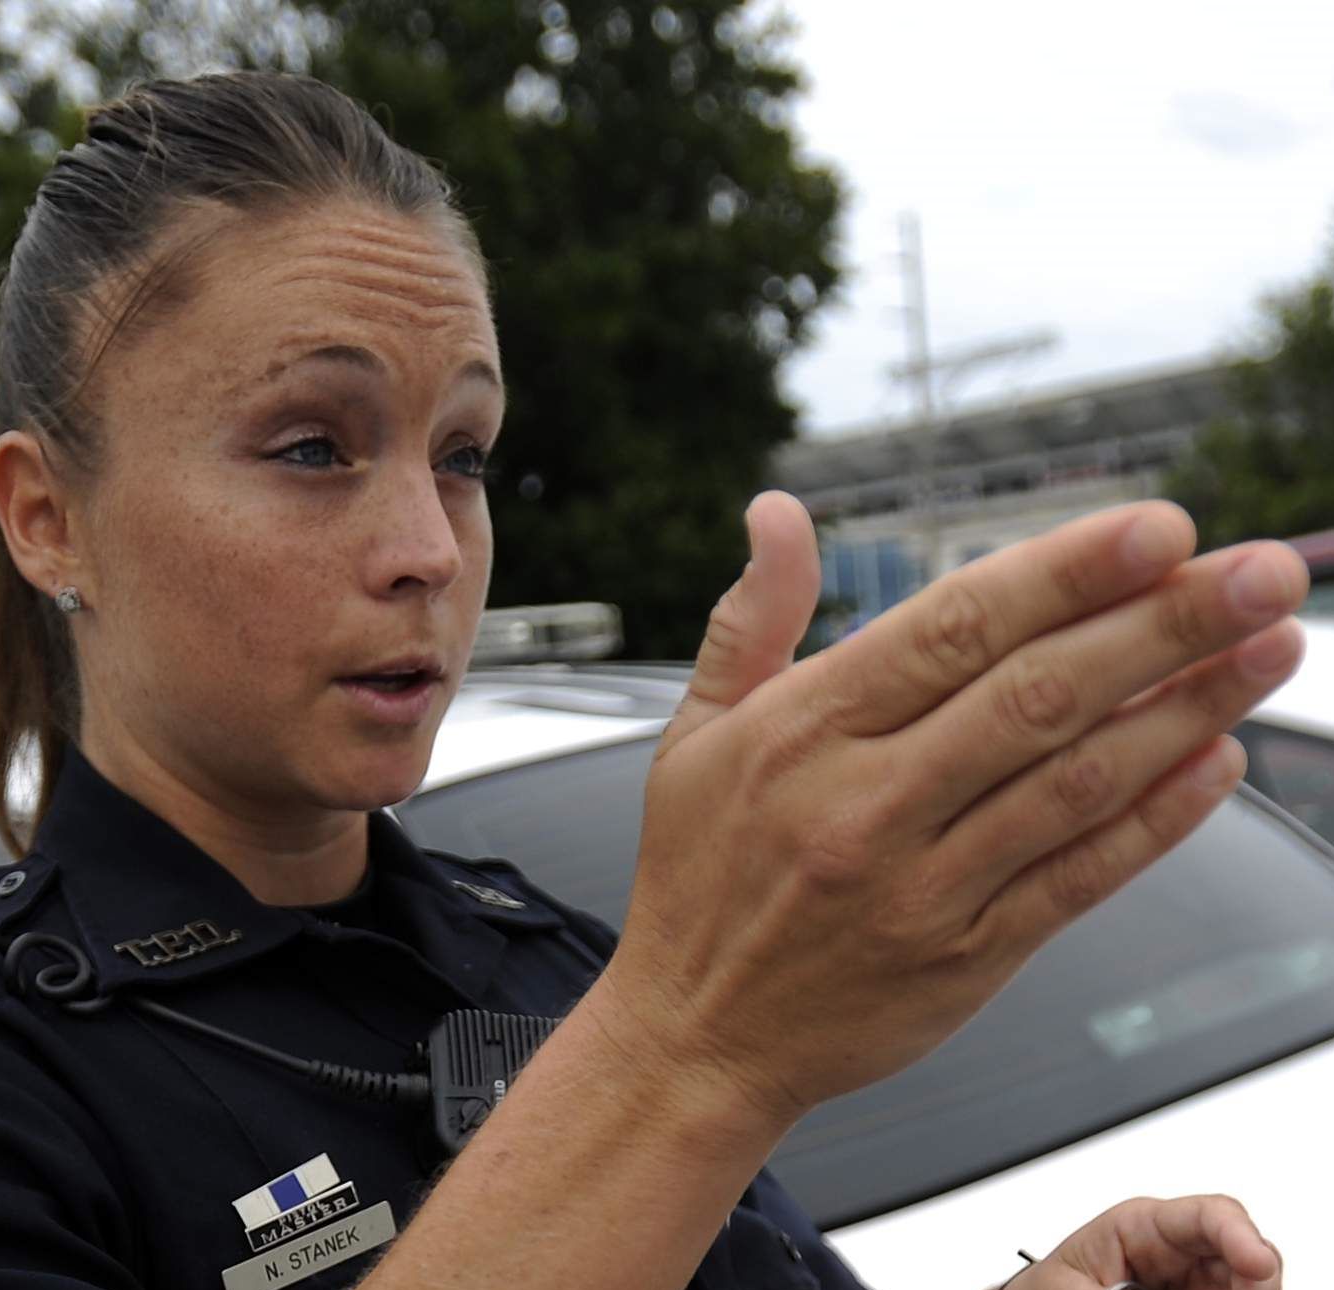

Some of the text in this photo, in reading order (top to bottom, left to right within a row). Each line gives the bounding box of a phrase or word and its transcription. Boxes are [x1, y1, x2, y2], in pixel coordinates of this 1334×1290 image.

[260, 1197, 348, 1245] MASTER
[264, 1226, 361, 1281] N. STANEK
